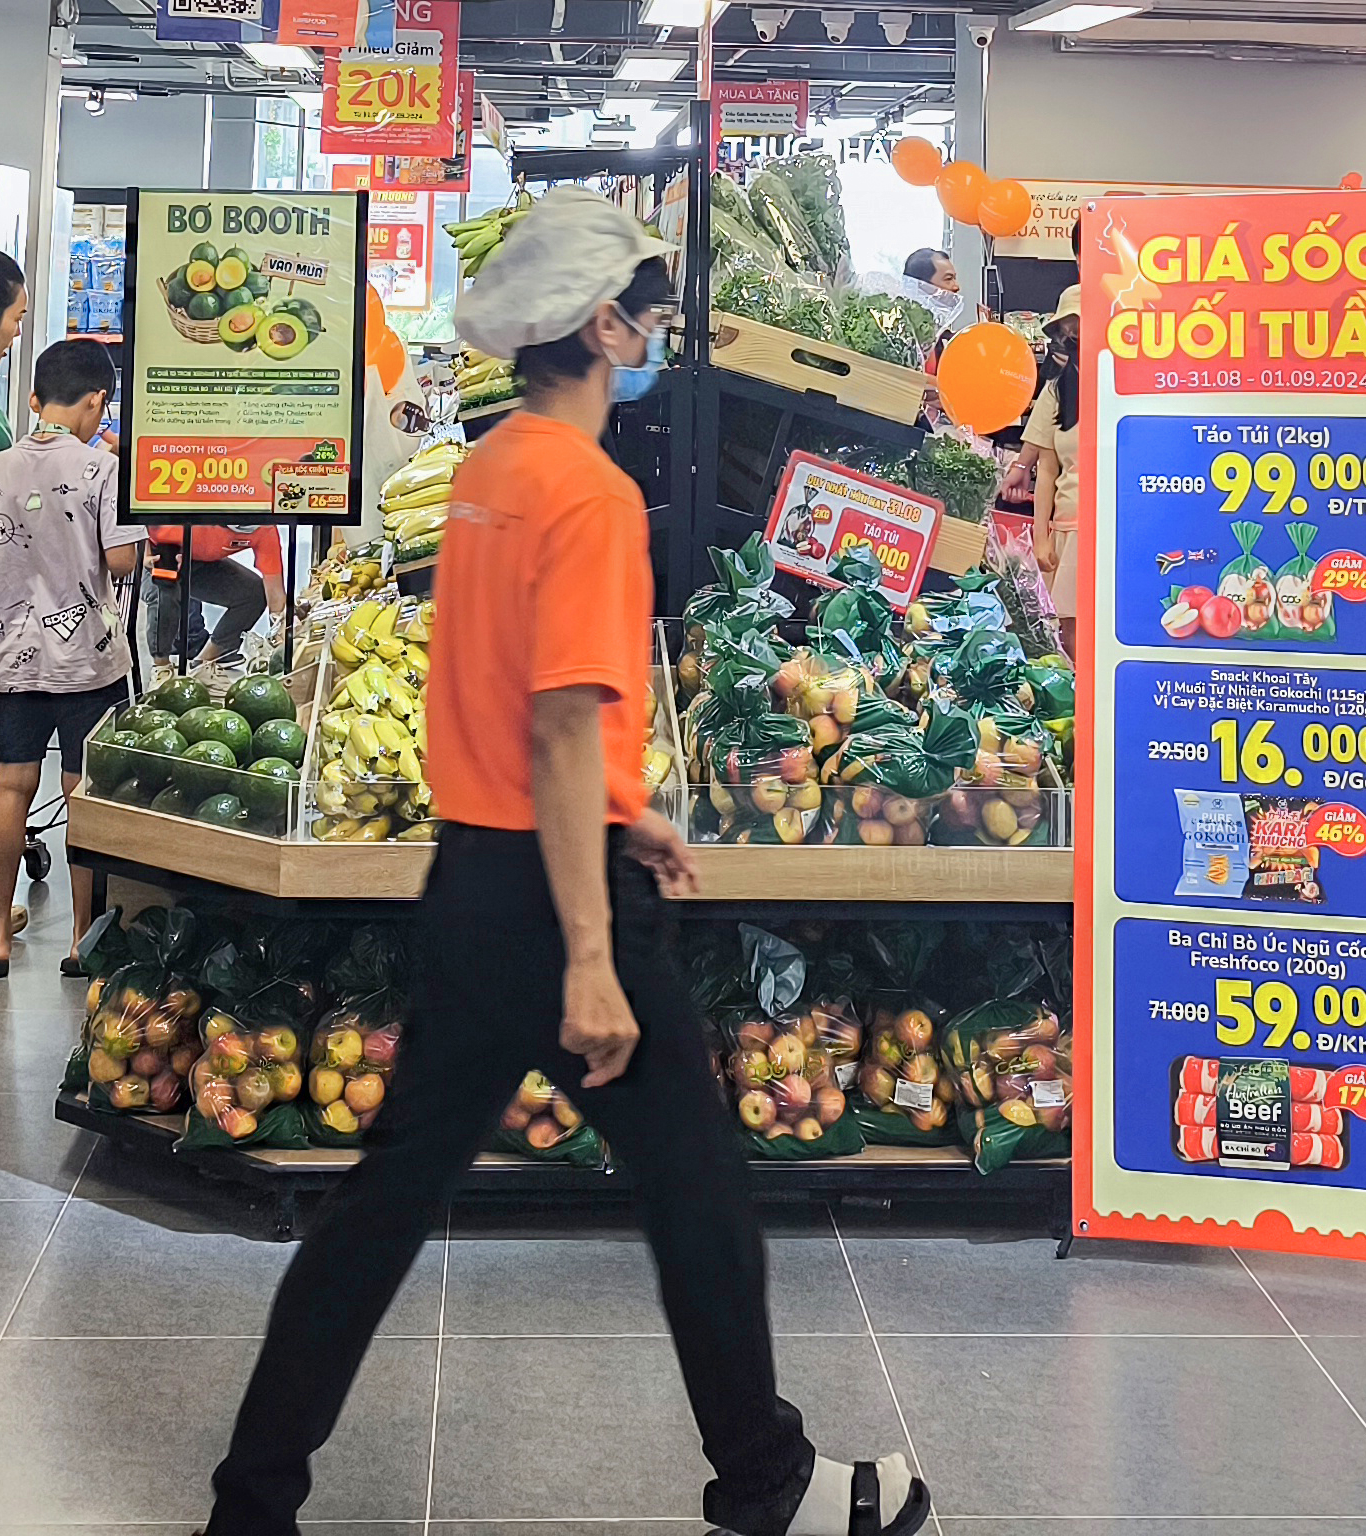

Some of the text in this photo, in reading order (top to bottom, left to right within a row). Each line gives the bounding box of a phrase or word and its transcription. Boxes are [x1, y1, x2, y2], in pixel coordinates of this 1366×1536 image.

[395, 41, 434, 56] Giảm
[347, 69, 431, 109] 20k
[719, 87, 799, 102] MUA LÀ TẶNG
[223, 205, 330, 236] BOOTH
[1139, 221, 1250, 284] GIÁ
[1107, 291, 1244, 360] CUỐI
[1154, 371, 1241, 389] 30-31.08
[1193, 424, 1330, 449] Táo Túi (2kg)
[170, 445, 204, 454] BOOTH
[207, 445, 228, 456] (KG)
[148, 457, 248, 494] 29.000
[1138, 475, 1206, 494] 139.000
[864, 522, 900, 545] TÁO TÚI
[1331, 557, 1362, 569] GIẢM
[1211, 669, 1318, 688] Snack Khoai Tây
[1156, 680, 1172, 696] Vị
[1174, 680, 1206, 695] Muối
[1208, 683, 1226, 698] Tự
[1228, 684, 1266, 697] Nhiên
[1269, 685, 1322, 700] Gokochi
[1153, 695, 1168, 710] Vị
[1171, 696, 1195, 711] Cay
[1198, 696, 1223, 713] Đặc
[1226, 697, 1253, 713] Biệt
[1256, 699, 1330, 715] Karamucho
[1148, 740, 1209, 761] 29.500
[1325, 808, 1357, 822] GIẢM
[1315, 824, 1365, 843] 46%
[1168, 930, 1192, 947] Ba
[1197, 932, 1227, 949] Chỉ
[1233, 934, 1257, 950] Bò
[1263, 932, 1287, 953] Úc
[1292, 938, 1330, 958] Ngũ
[1190, 951, 1346, 980] Freshfoco (200g)
[1229, 1099, 1282, 1122] Beef
